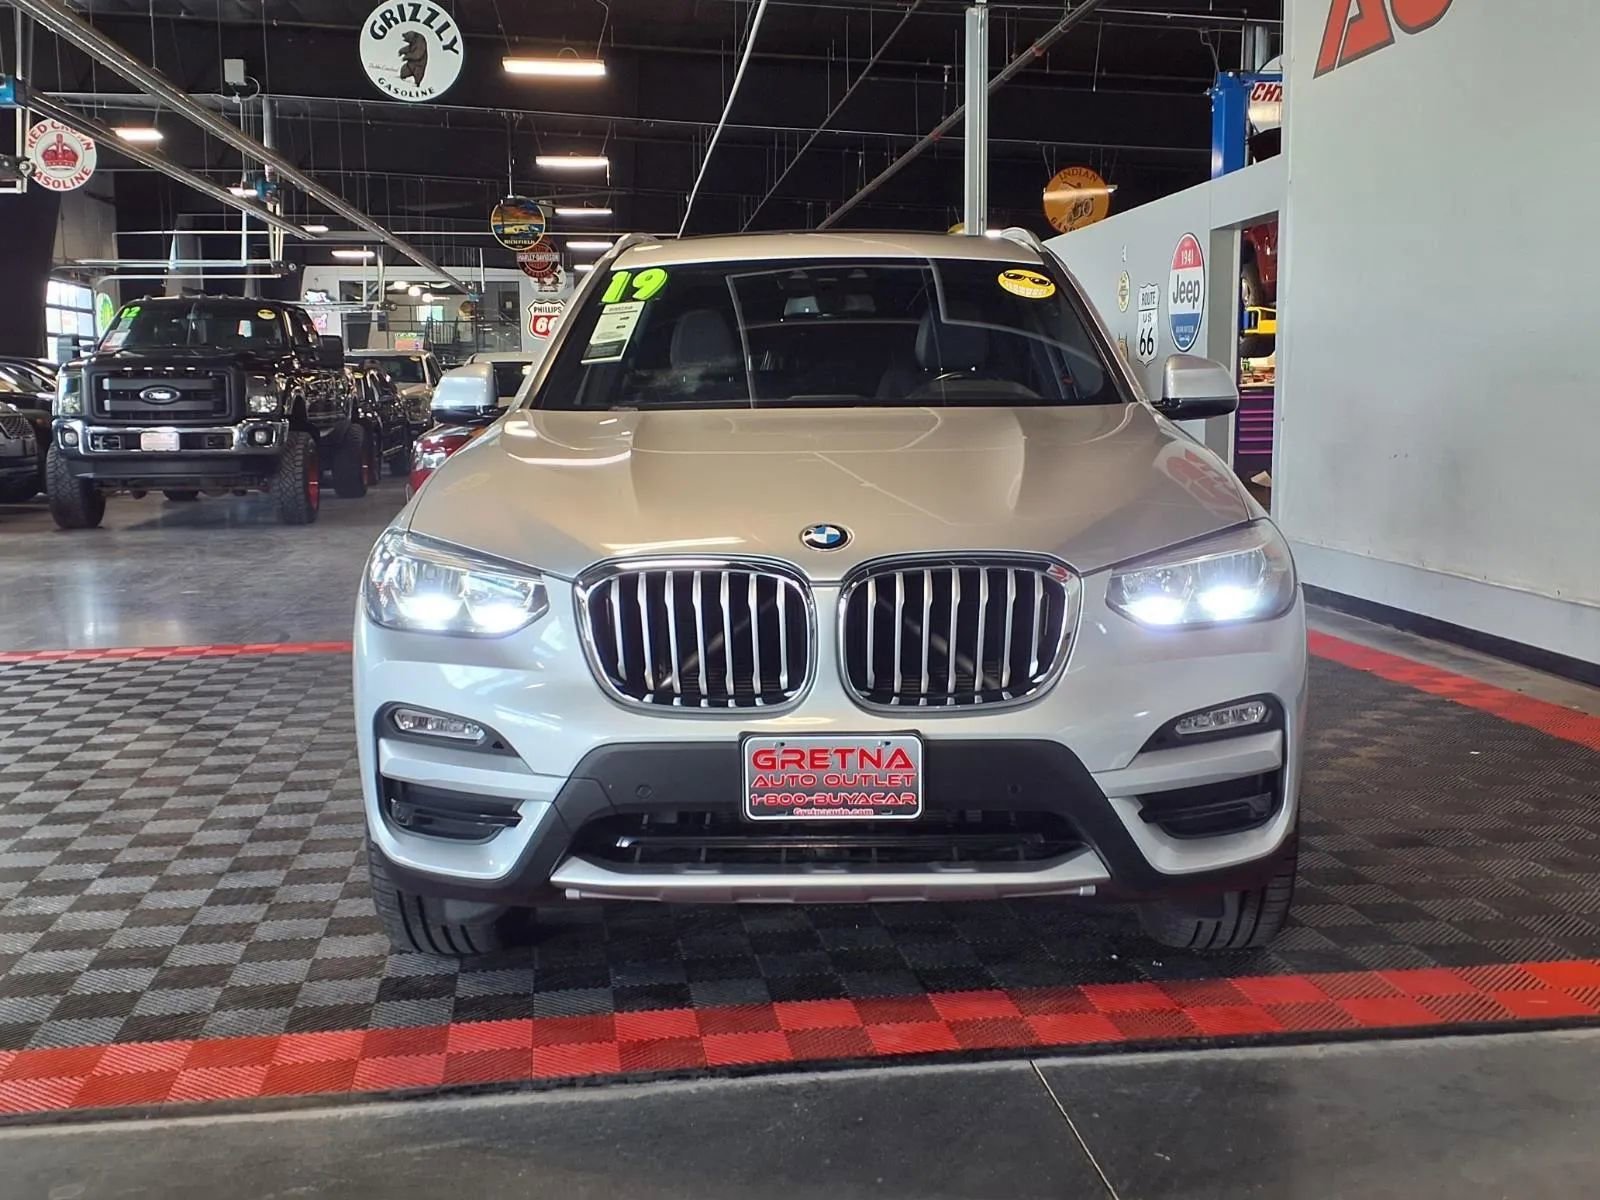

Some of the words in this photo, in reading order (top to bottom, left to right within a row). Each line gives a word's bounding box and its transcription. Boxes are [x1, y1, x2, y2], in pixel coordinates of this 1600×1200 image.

[370, 2, 459, 55] GRIZZLY
[378, 77, 435, 98] GASOLINE
[1059, 168, 1098, 183] INDIAN
[1181, 249, 1194, 265] 1941
[601, 268, 668, 303] 19
[1172, 274, 1201, 310] Jeep
[1141, 291, 1156, 306] ROUTE
[120, 306, 141, 319] 12
[1142, 312, 1152, 323] US
[1140, 327, 1154, 356] 66
[752, 747, 915, 771] GRETNA
[751, 773, 817, 788] AUTO
[823, 772, 917, 788] OUTLET
[751, 792, 917, 806] 1-800-BUYACAR
